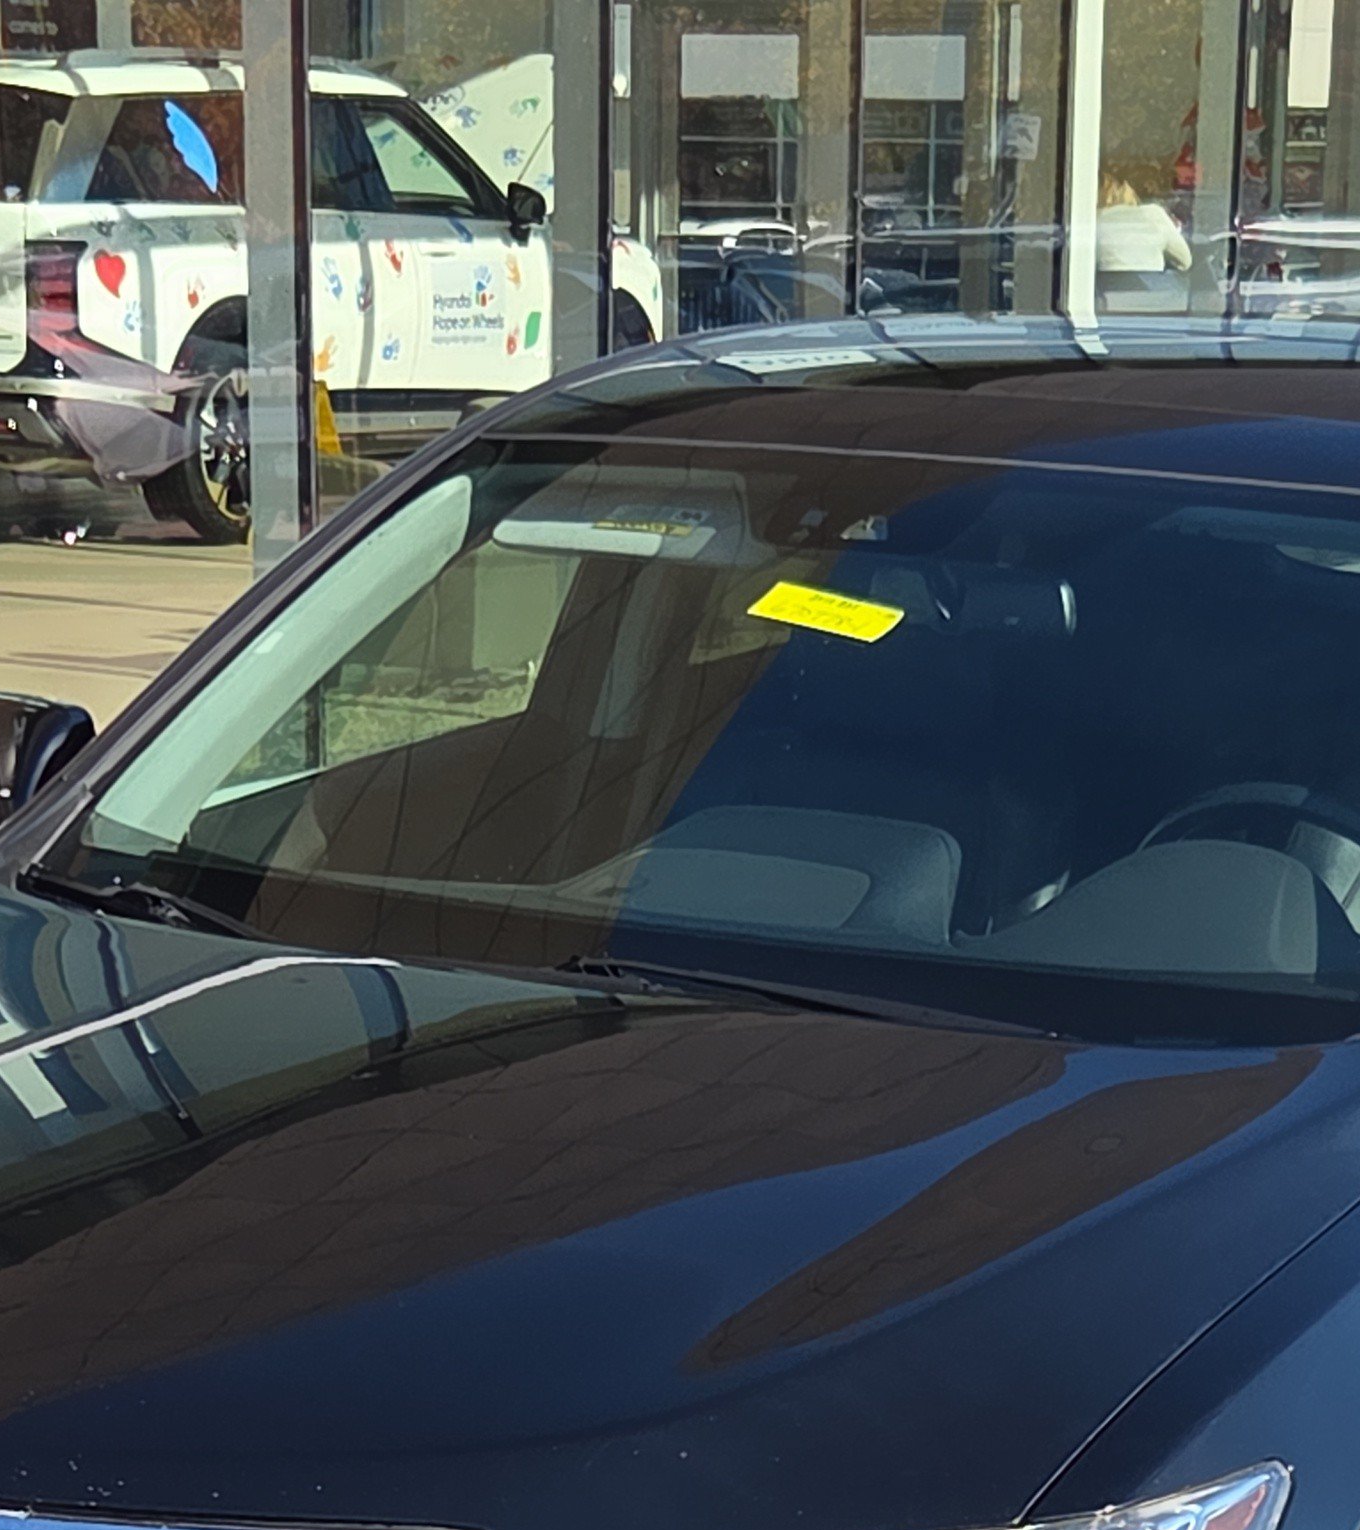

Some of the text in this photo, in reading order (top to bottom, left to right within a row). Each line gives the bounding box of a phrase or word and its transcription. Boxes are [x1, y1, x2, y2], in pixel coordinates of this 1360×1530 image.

[433, 293, 472, 312] Hyundai
[433, 314, 457, 332] Hope
[472, 312, 505, 330] Wheels
